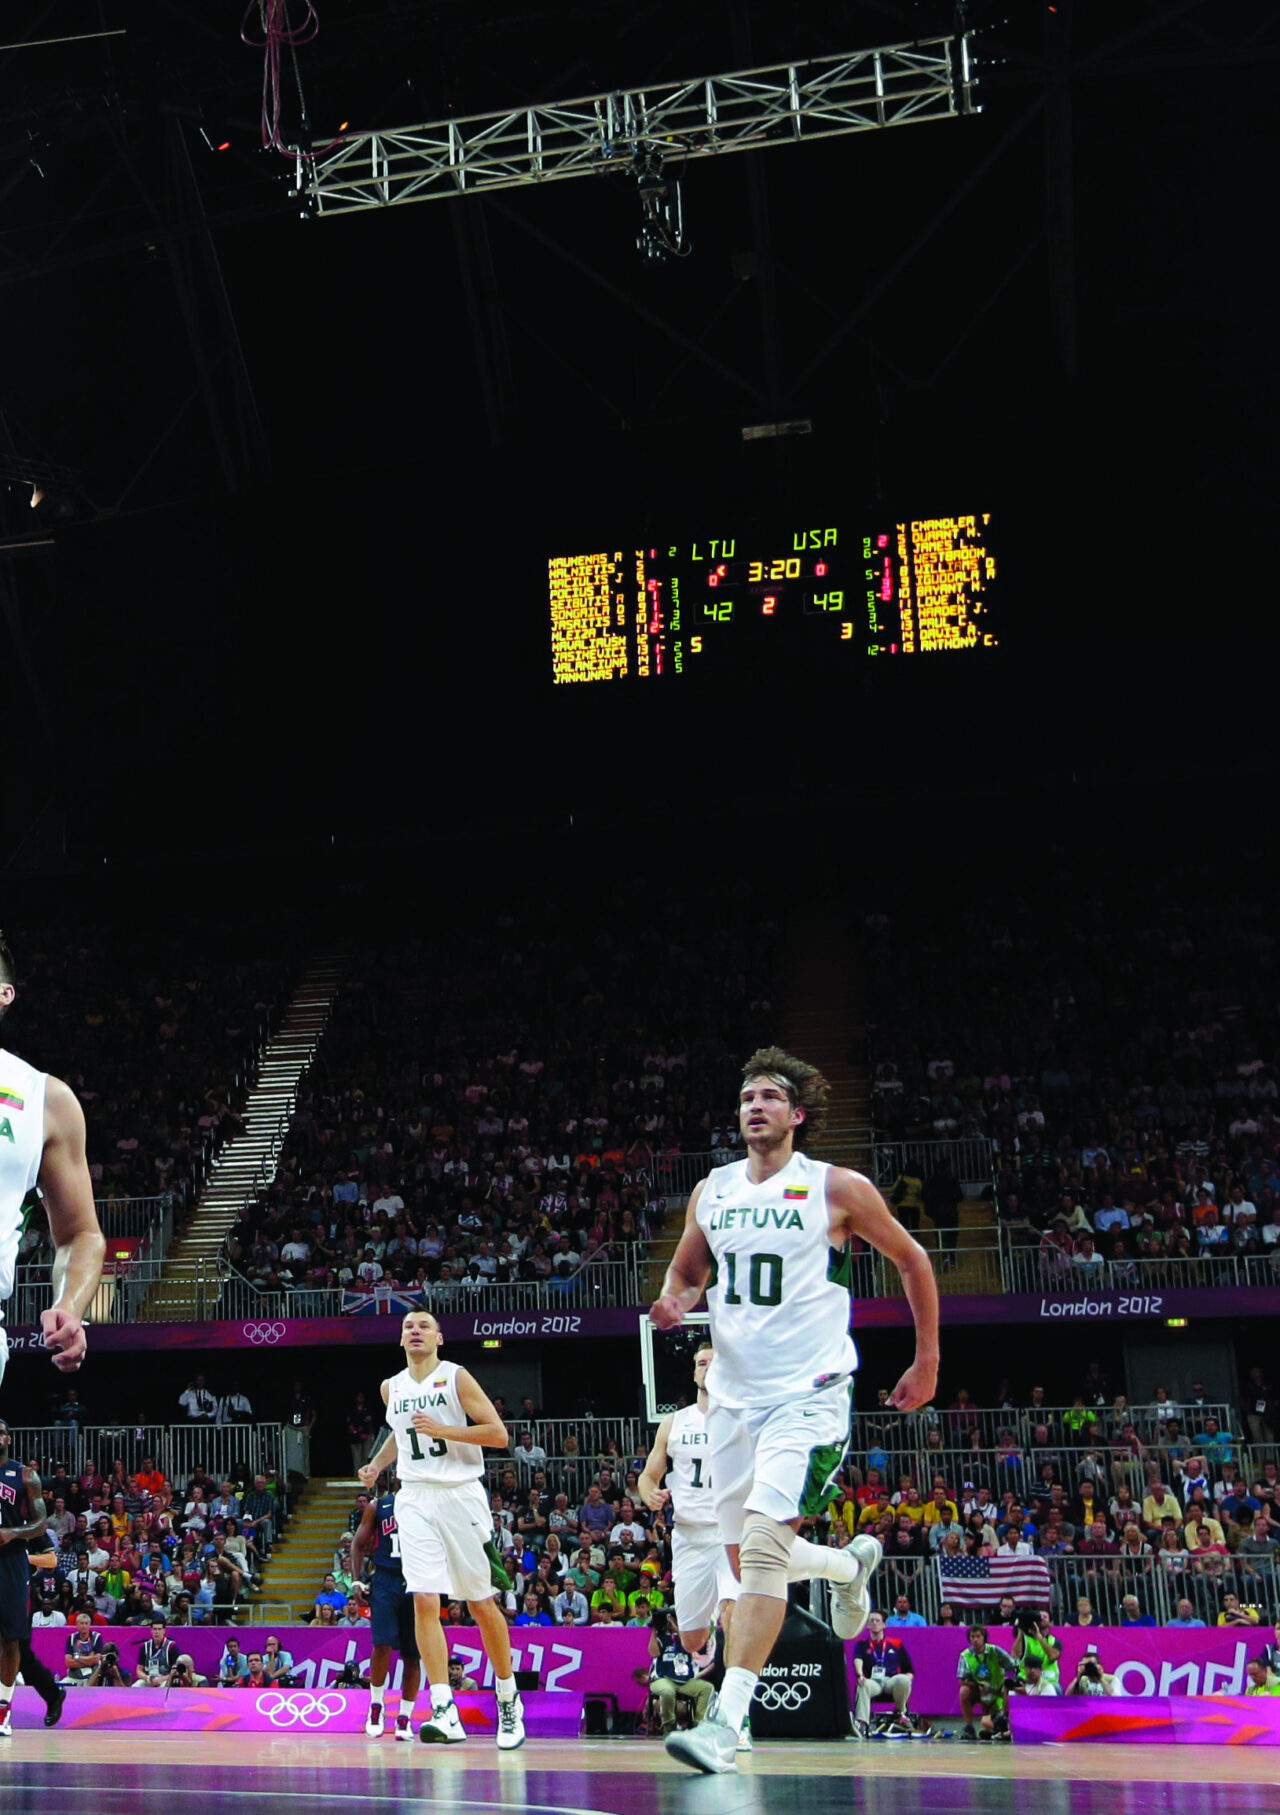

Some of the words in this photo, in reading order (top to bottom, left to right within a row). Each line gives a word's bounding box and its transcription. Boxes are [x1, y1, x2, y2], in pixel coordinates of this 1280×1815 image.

[911, 515, 975, 532] CHANDLER
[793, 528, 837, 550] USA
[913, 539, 953, 554] JAMES
[668, 546, 677, 557] 2
[692, 539, 735, 561] LTU
[748, 558, 801, 582] 3:20
[550, 586, 594, 600] POCIUS
[813, 591, 843, 611] 49
[703, 602, 733, 621] 42
[762, 597, 776, 615] 2
[841, 622, 853, 639] 3
[691, 636, 702, 652] 5
[868, 644, 879, 655] 12
[921, 636, 977, 652] ANTHONY
[710, 1208, 804, 1231] LIETUVA
[724, 1253, 783, 1307] 10
[1040, 1297, 1112, 1316] London
[1117, 1296, 1163, 1314] 2012
[473, 1317, 536, 1335] London
[541, 1316, 581, 1333] 2012
[394, 1393, 447, 1414] LIETUVA
[791, 1663, 822, 1677] 2012
